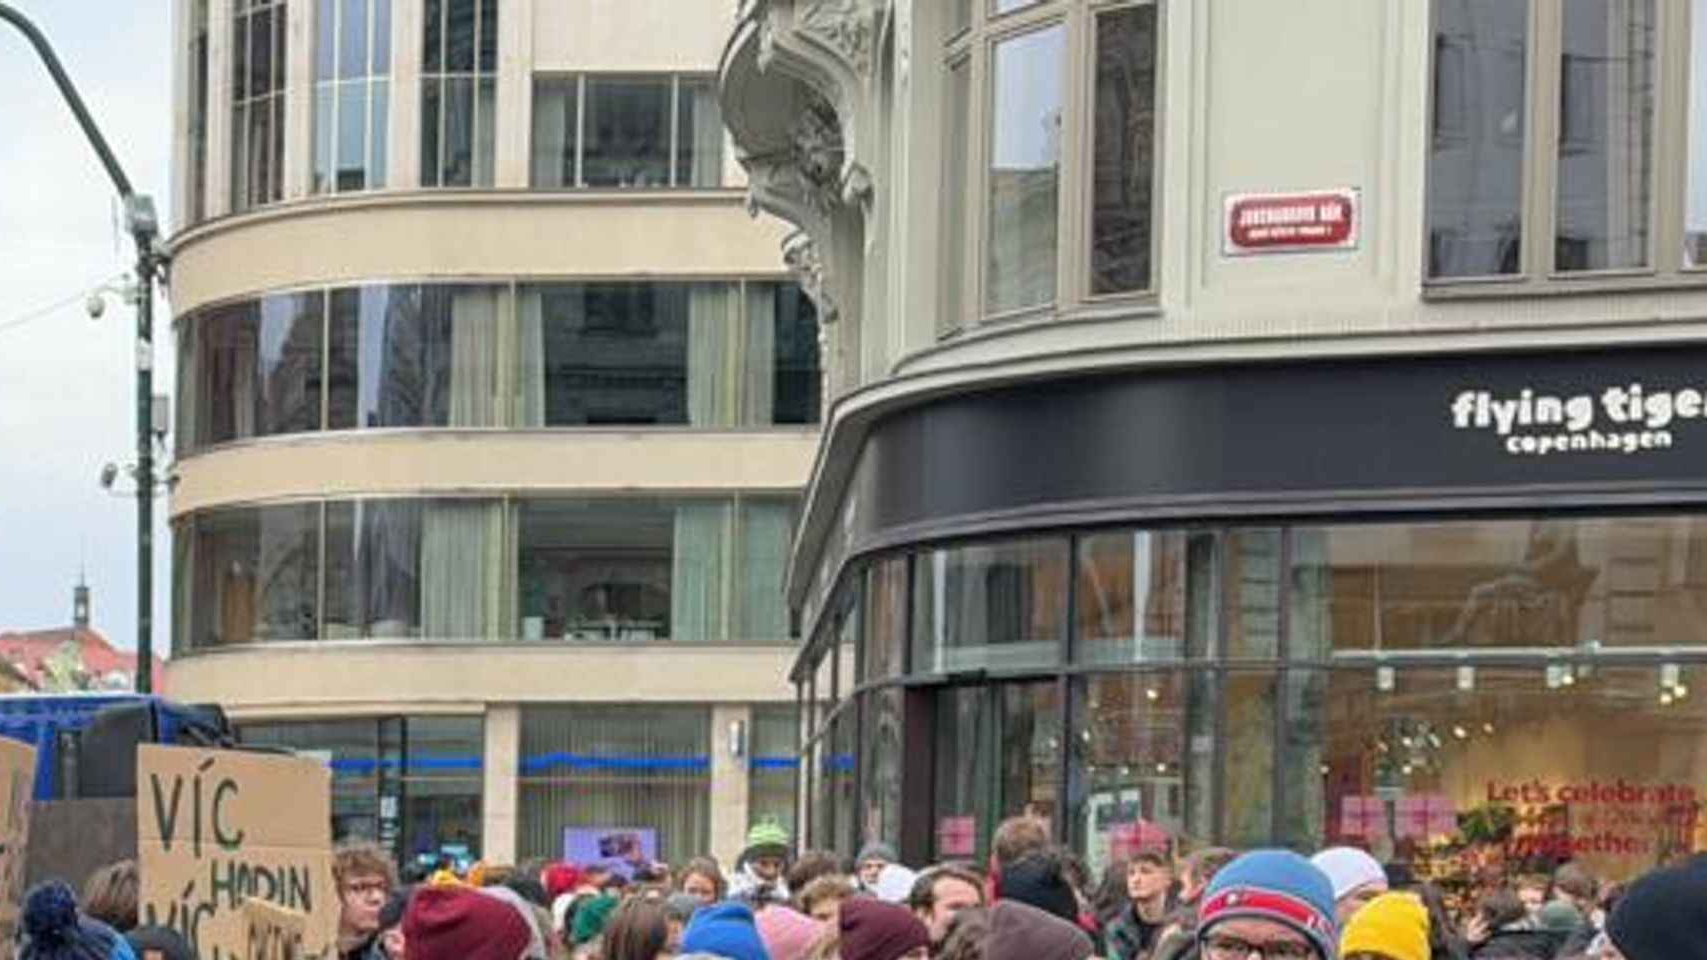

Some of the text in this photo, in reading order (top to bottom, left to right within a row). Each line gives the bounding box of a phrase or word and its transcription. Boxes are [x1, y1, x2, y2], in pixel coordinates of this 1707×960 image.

[1451, 383, 1707, 434] flying tige
[151, 757, 245, 859] VÍC
